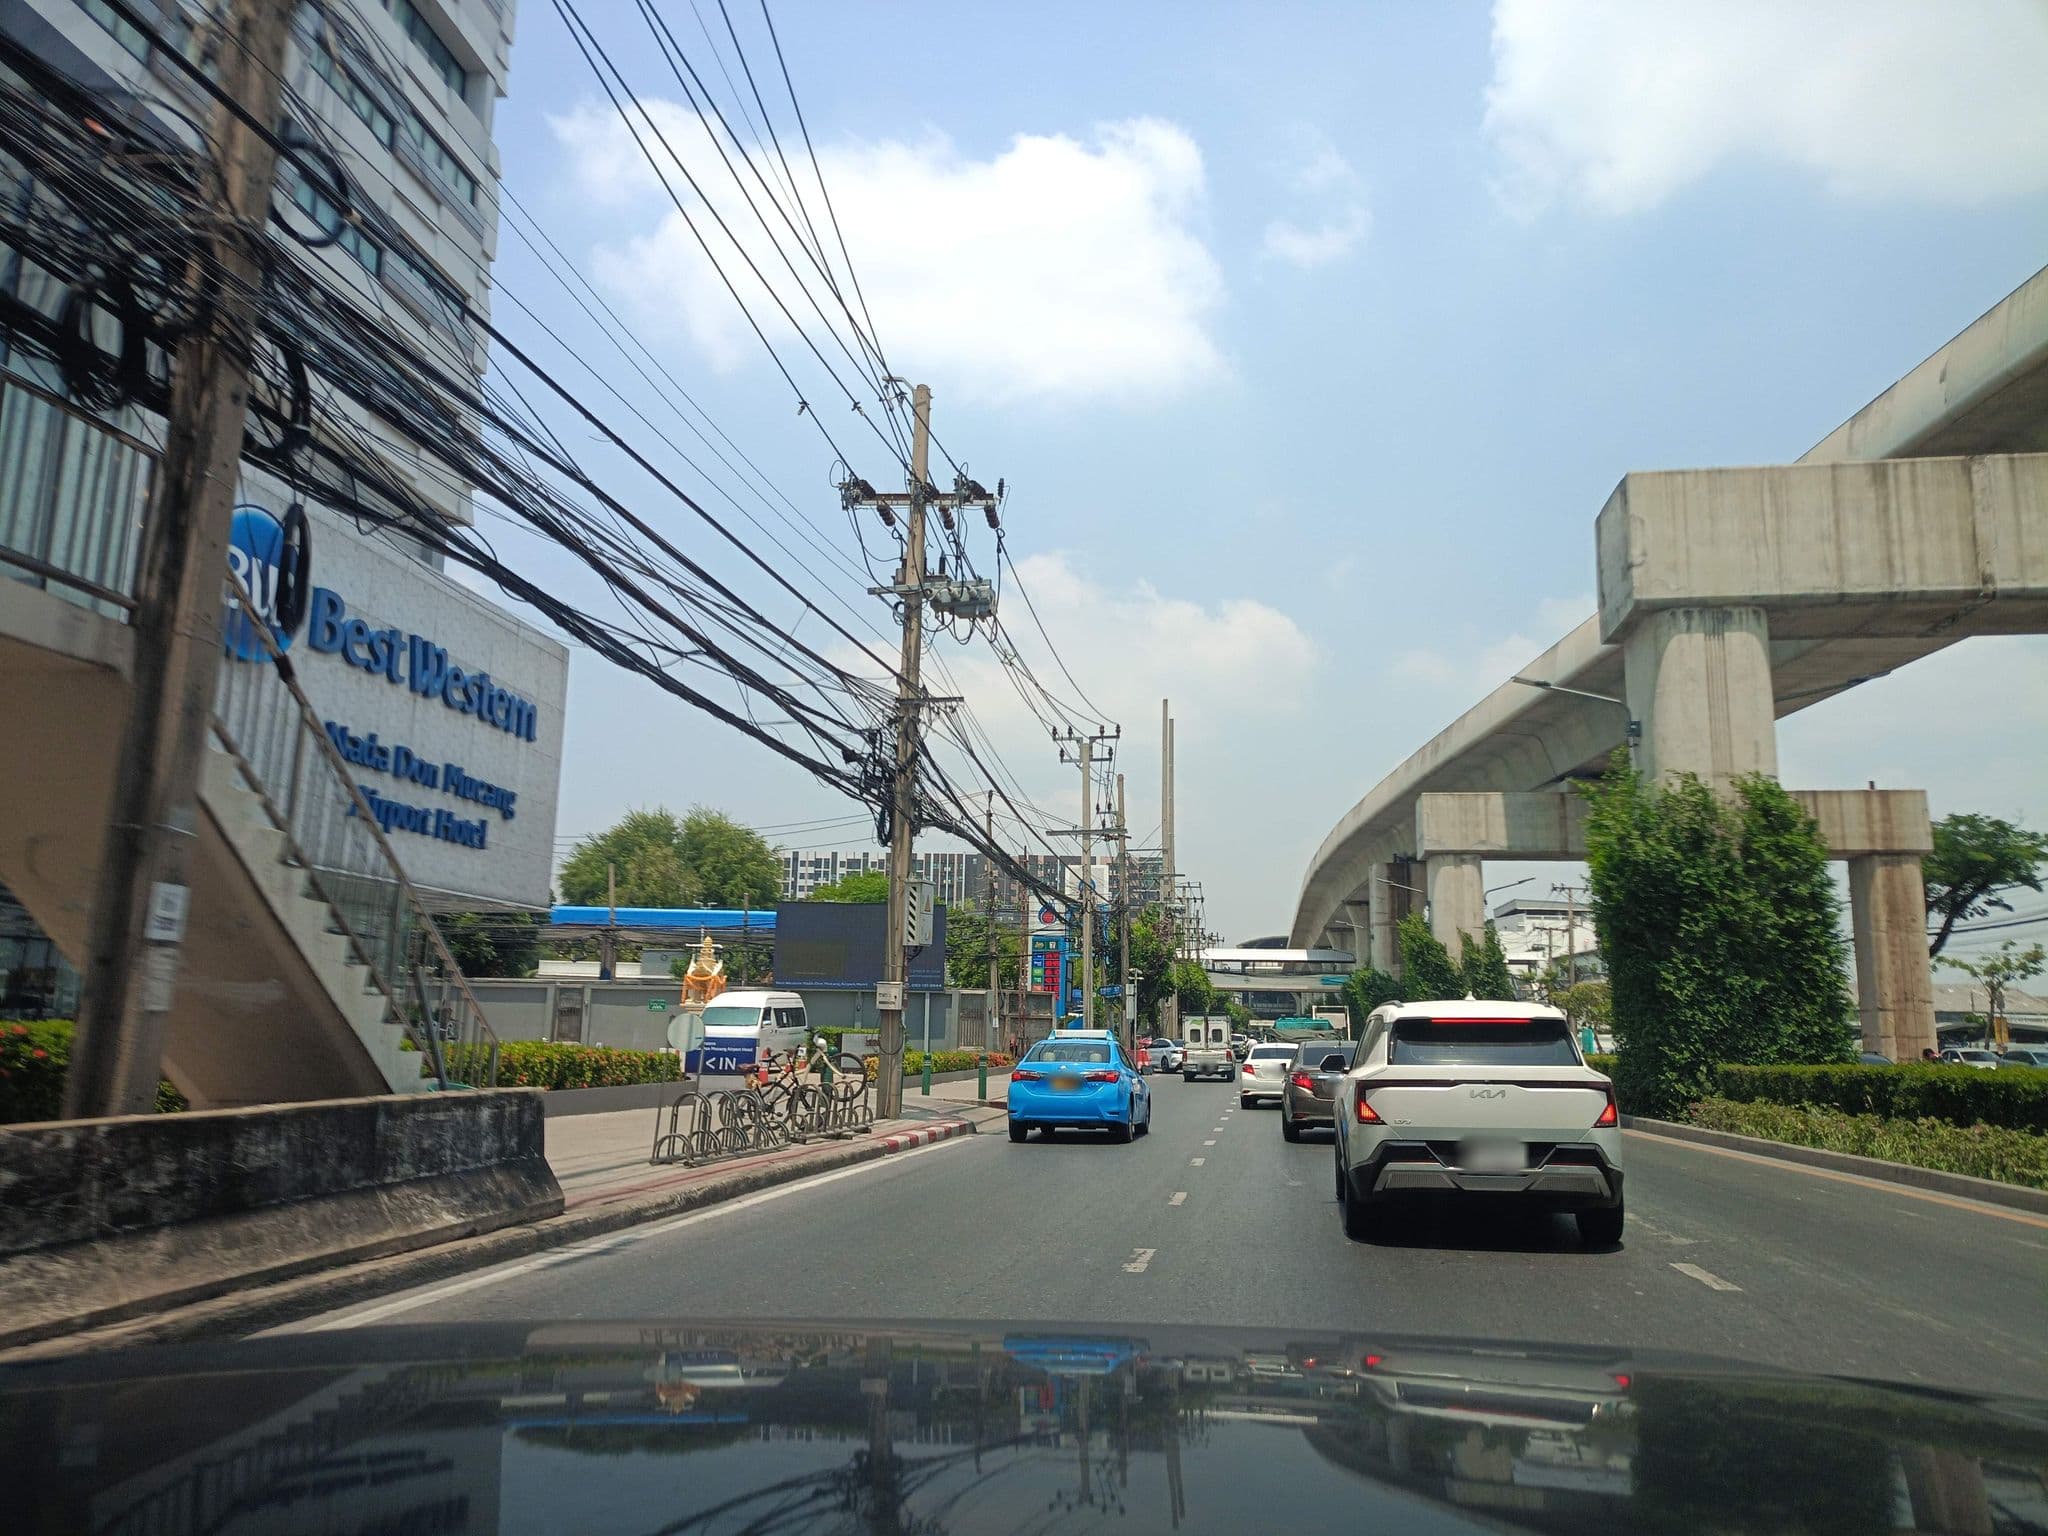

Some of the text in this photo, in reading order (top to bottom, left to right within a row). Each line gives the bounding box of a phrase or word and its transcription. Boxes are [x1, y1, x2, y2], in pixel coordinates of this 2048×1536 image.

[309, 587, 538, 742] Best Western
[325, 721, 390, 772] Nada
[393, 745, 439, 789] Don
[434, 808, 488, 850] Hotel
[719, 1057, 736, 1070] IN
[1470, 1089, 1506, 1098] KIA
